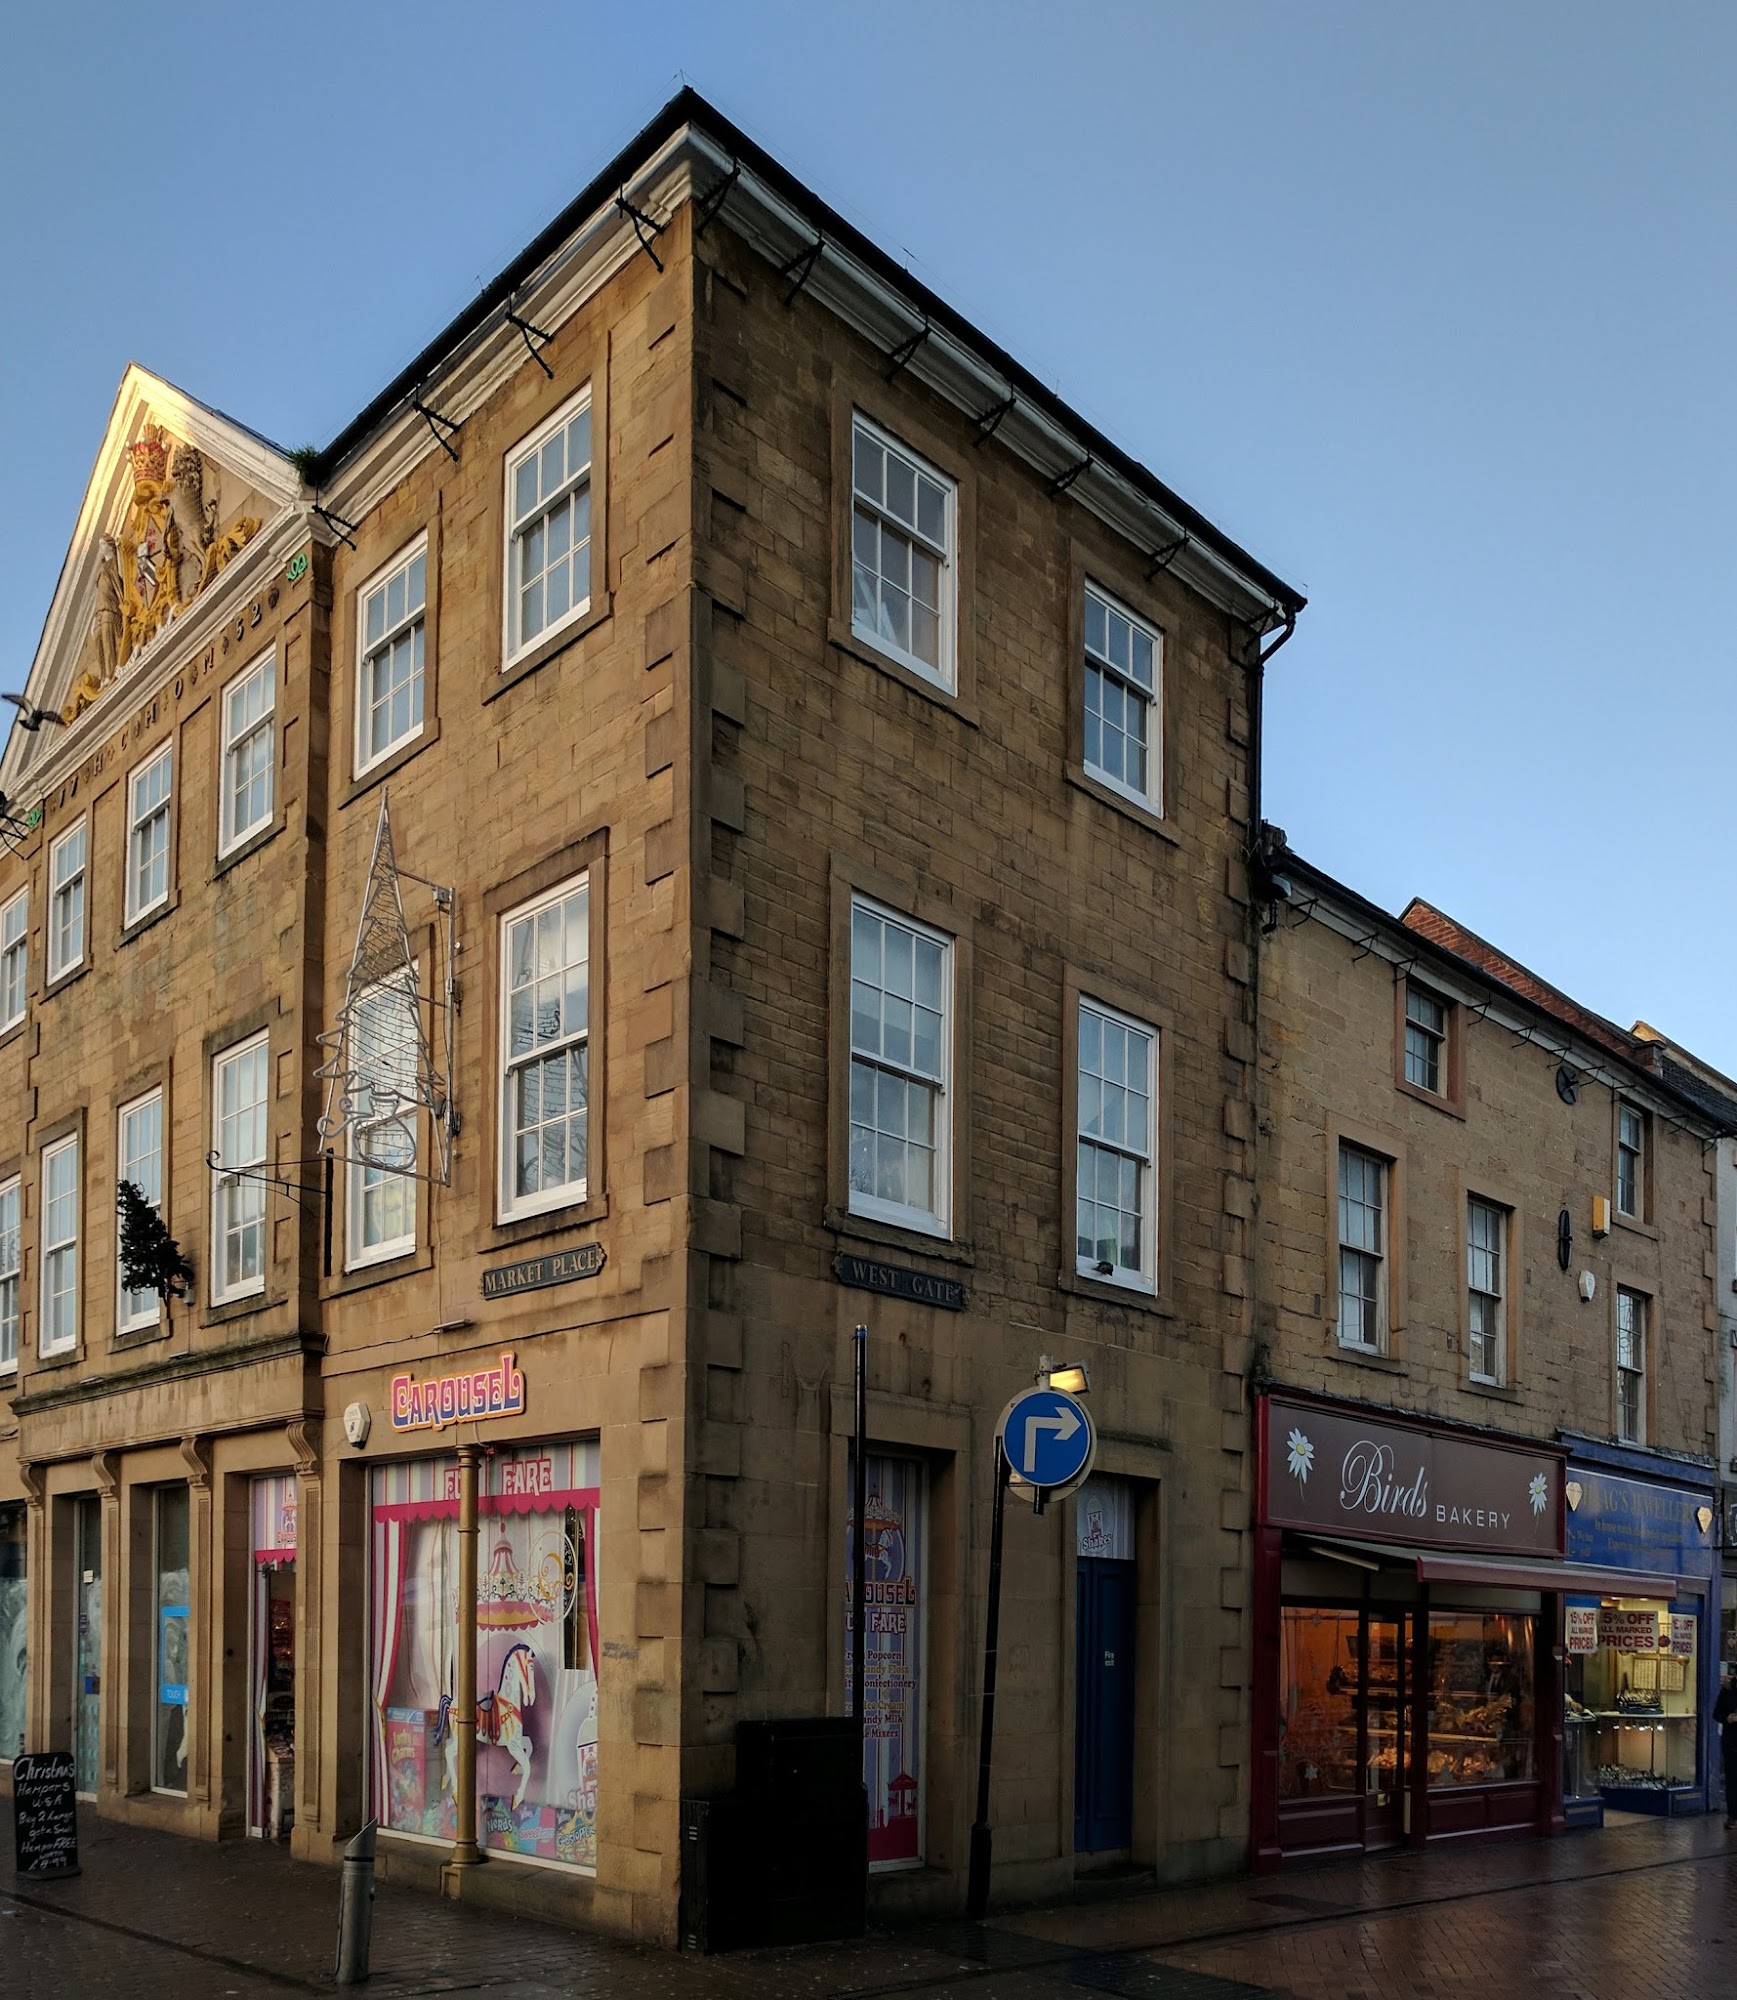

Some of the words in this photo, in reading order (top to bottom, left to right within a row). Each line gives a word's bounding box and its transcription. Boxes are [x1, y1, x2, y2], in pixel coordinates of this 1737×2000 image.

[485, 1262, 543, 1293] MARKET
[552, 1250, 596, 1277] PLACE
[852, 1261, 898, 1288] WEST
[912, 1275, 954, 1302] GATE
[392, 1353, 522, 1428] CAROUSEL
[502, 1459, 551, 1497] FARE
[1340, 1439, 1429, 1518] Birds
[1436, 1504, 1511, 1530] BAKERY
[870, 1611, 906, 1635] FARE
[1602, 1612, 1625, 1625] 5%
[1627, 1613, 1655, 1625] OFF
[1616, 1626, 1653, 1634] MARKED
[1570, 1636, 1594, 1650] PRICES
[1598, 1634, 1655, 1648] PRICES
[867, 1650, 902, 1662] Popcorn
[887, 1663, 910, 1675] Floss
[864, 1678, 917, 1690] onfectionery
[878, 1700, 905, 1711] Cream
[885, 1712, 903, 1724] Milk
[871, 1729, 899, 1738] Mixers
[568, 1788, 598, 1811] Sha
[38, 1810, 46, 1822] 2
[53, 1836, 77, 1849] FREE
